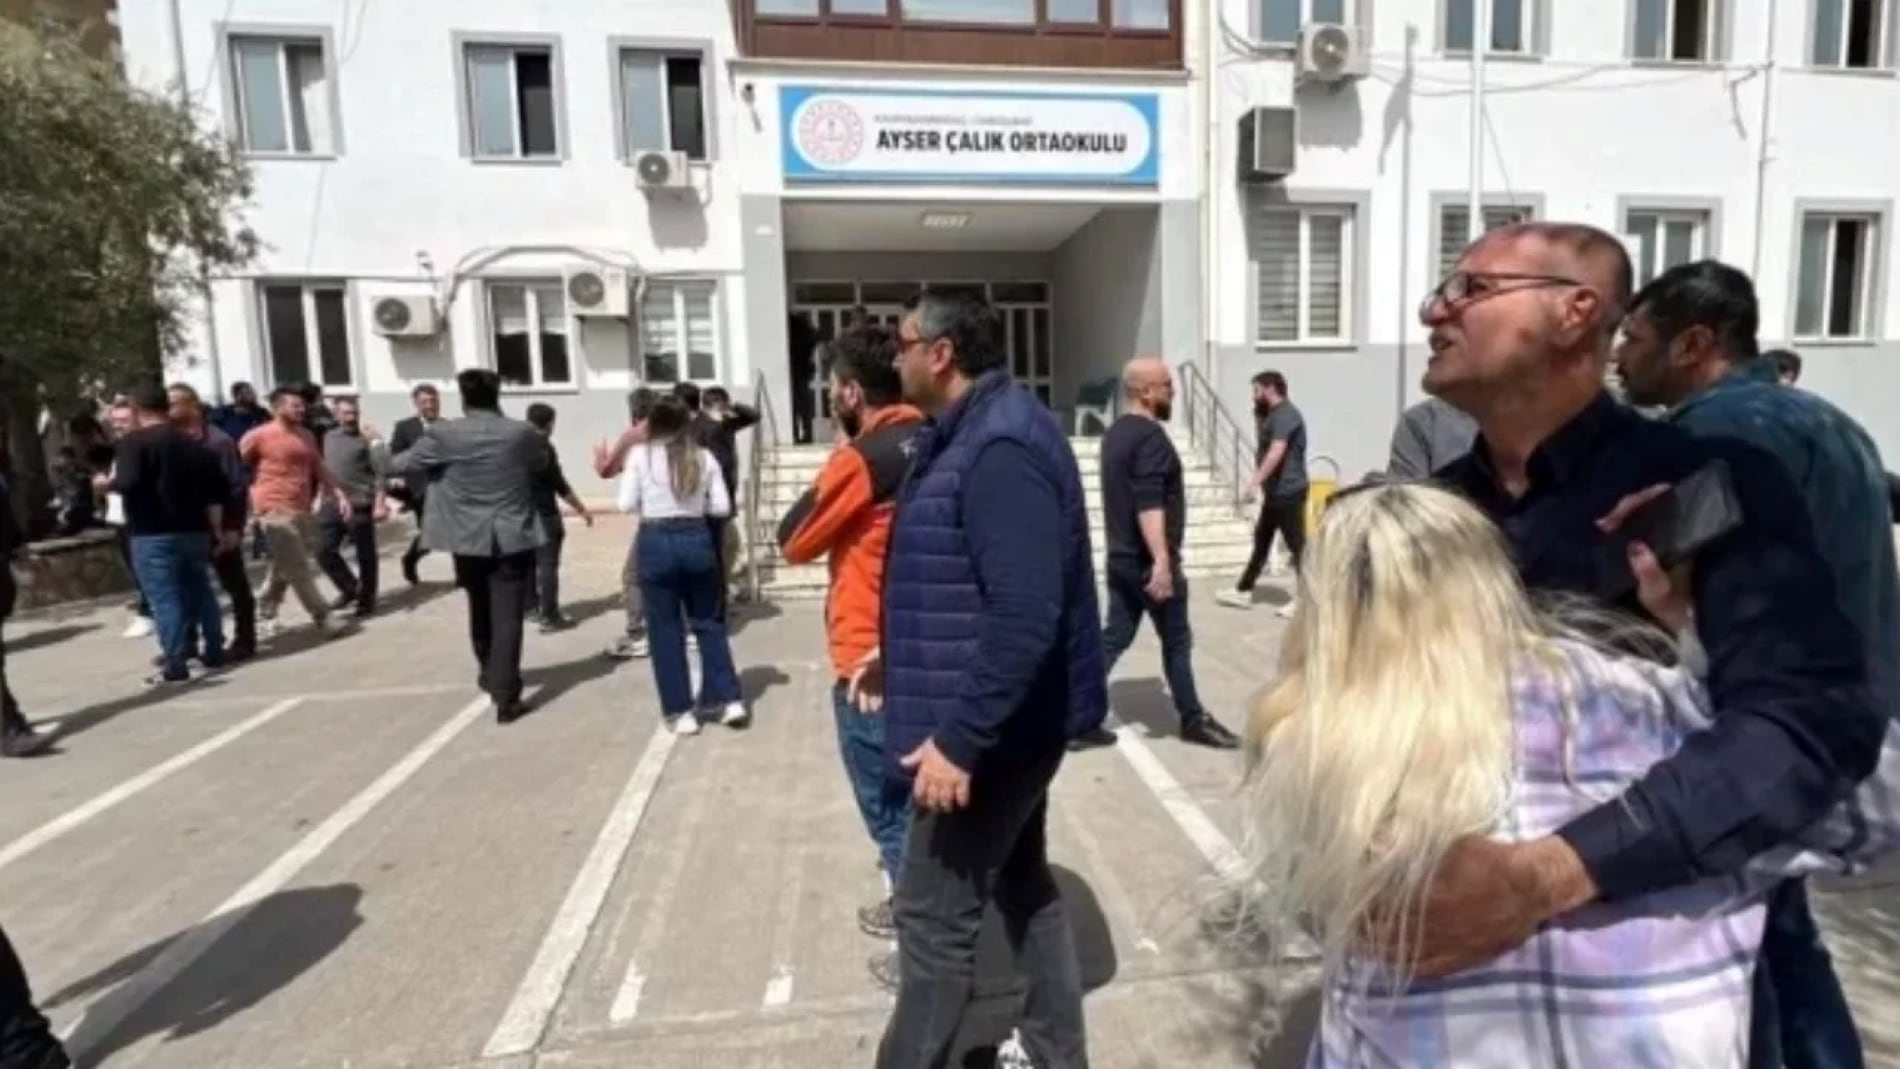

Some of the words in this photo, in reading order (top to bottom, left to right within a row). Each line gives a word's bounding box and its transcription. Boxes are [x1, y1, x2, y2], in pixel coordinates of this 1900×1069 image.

[876, 129, 941, 151] AYSER
[945, 130, 1005, 154] ÇALIK
[1009, 131, 1127, 153] ORTAOKULU
